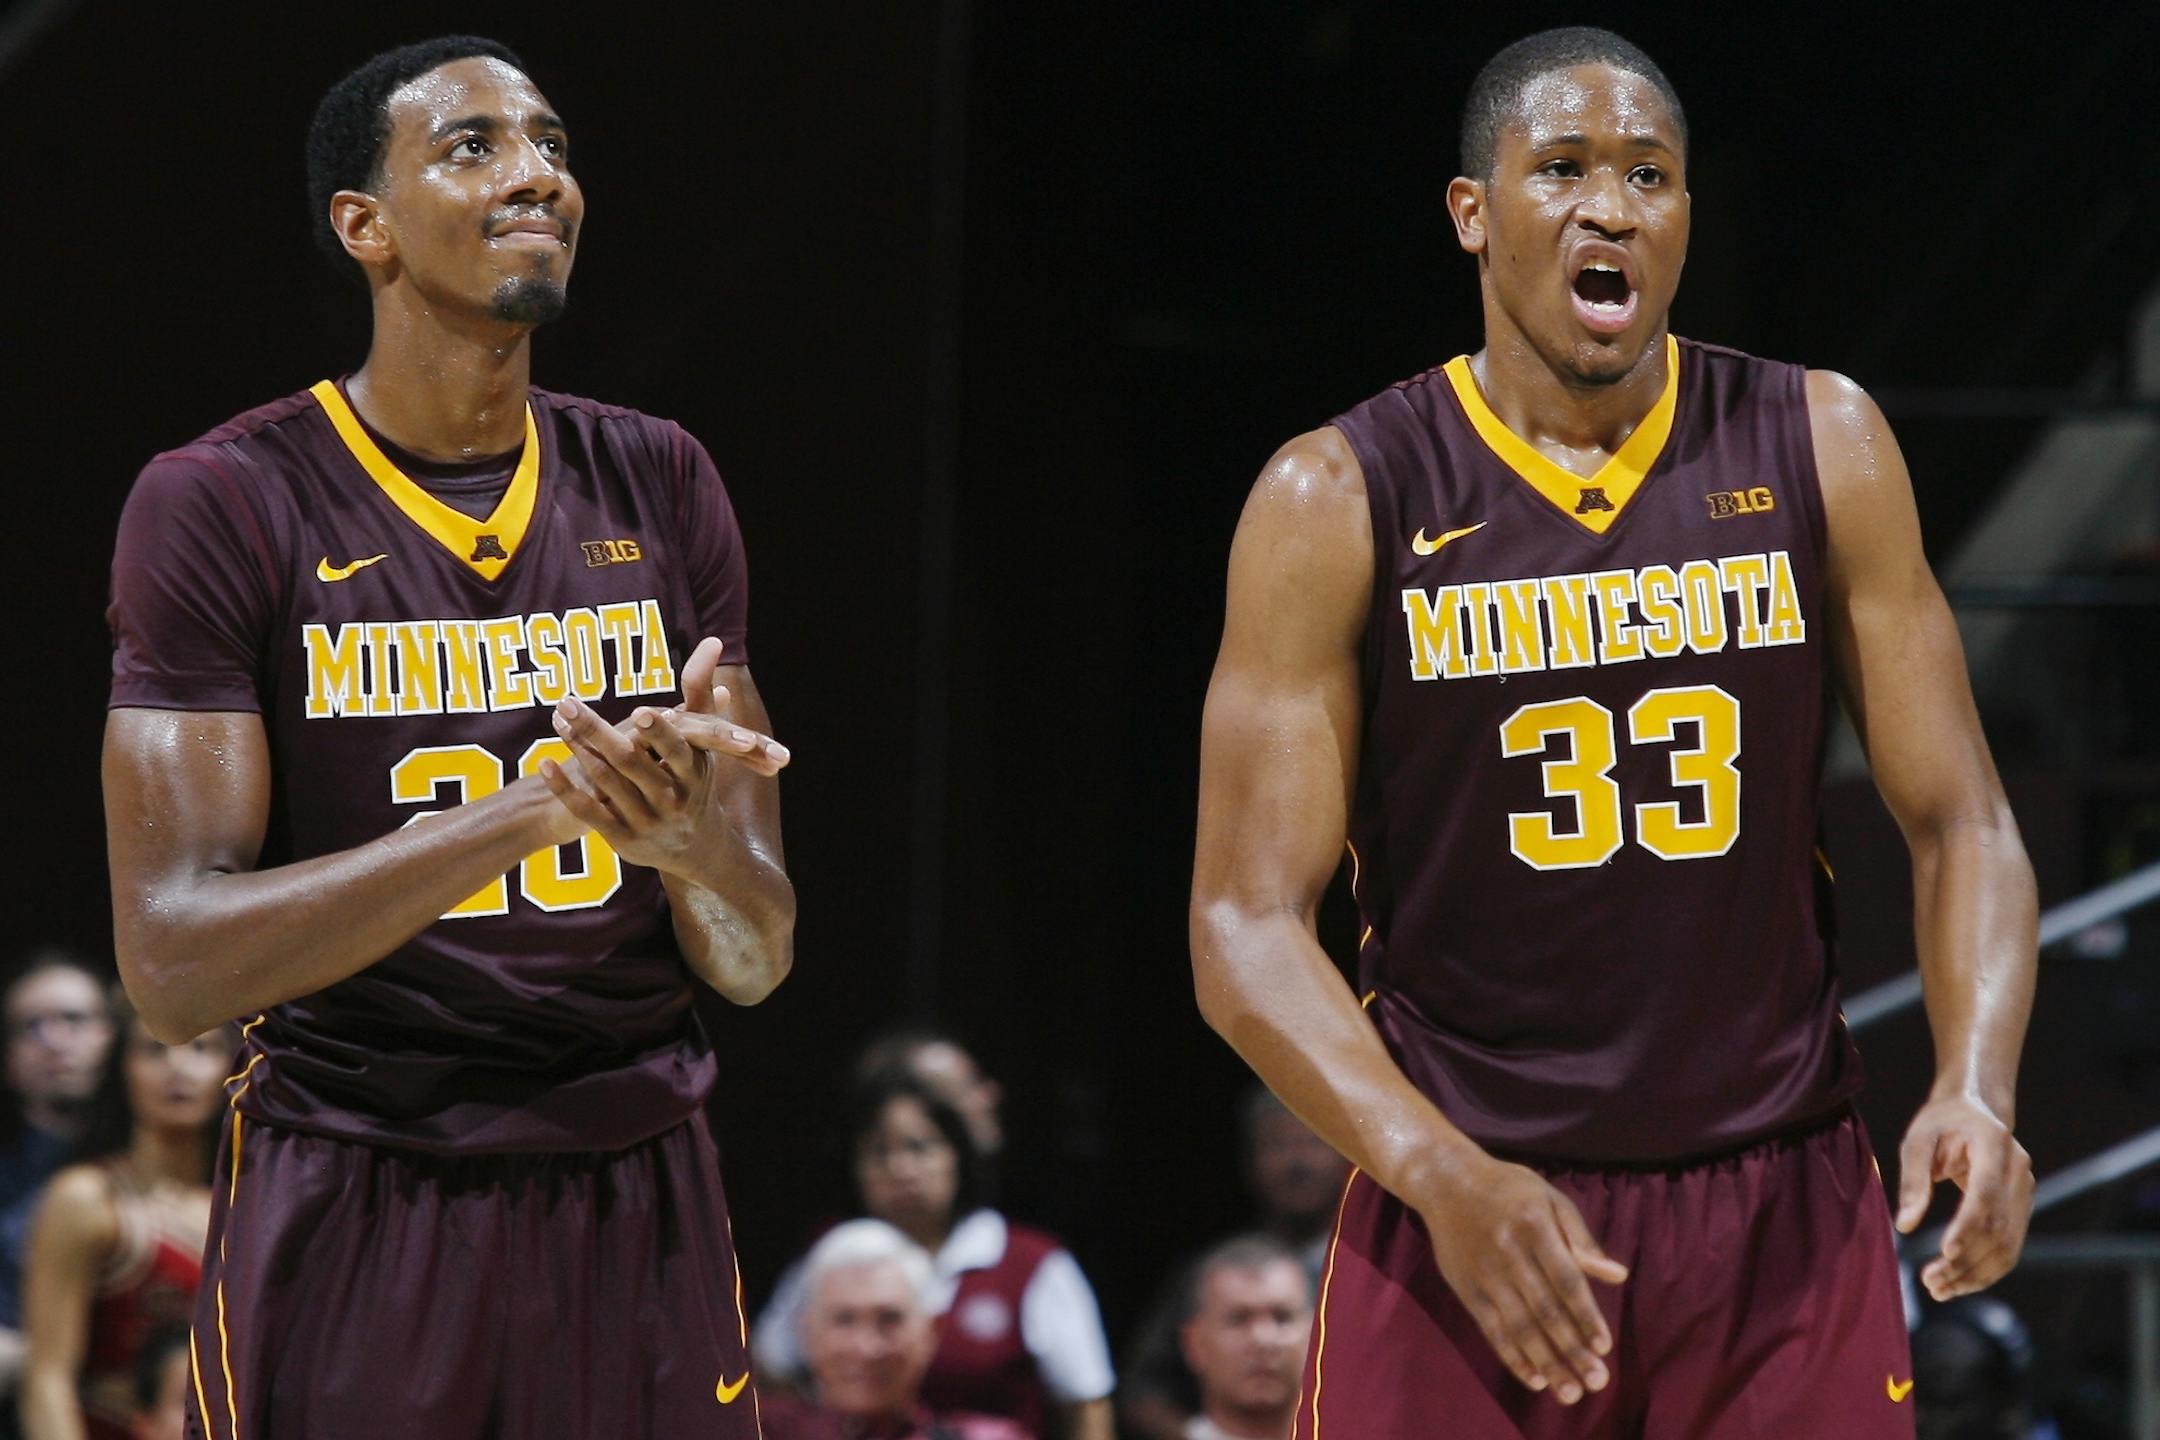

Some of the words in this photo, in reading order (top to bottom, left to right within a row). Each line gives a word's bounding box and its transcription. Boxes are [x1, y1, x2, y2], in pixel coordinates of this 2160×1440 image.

[302, 599, 677, 720] MINNESOTA
[1401, 551, 1806, 682] MINNESOTA
[1499, 684, 1742, 871] 33
